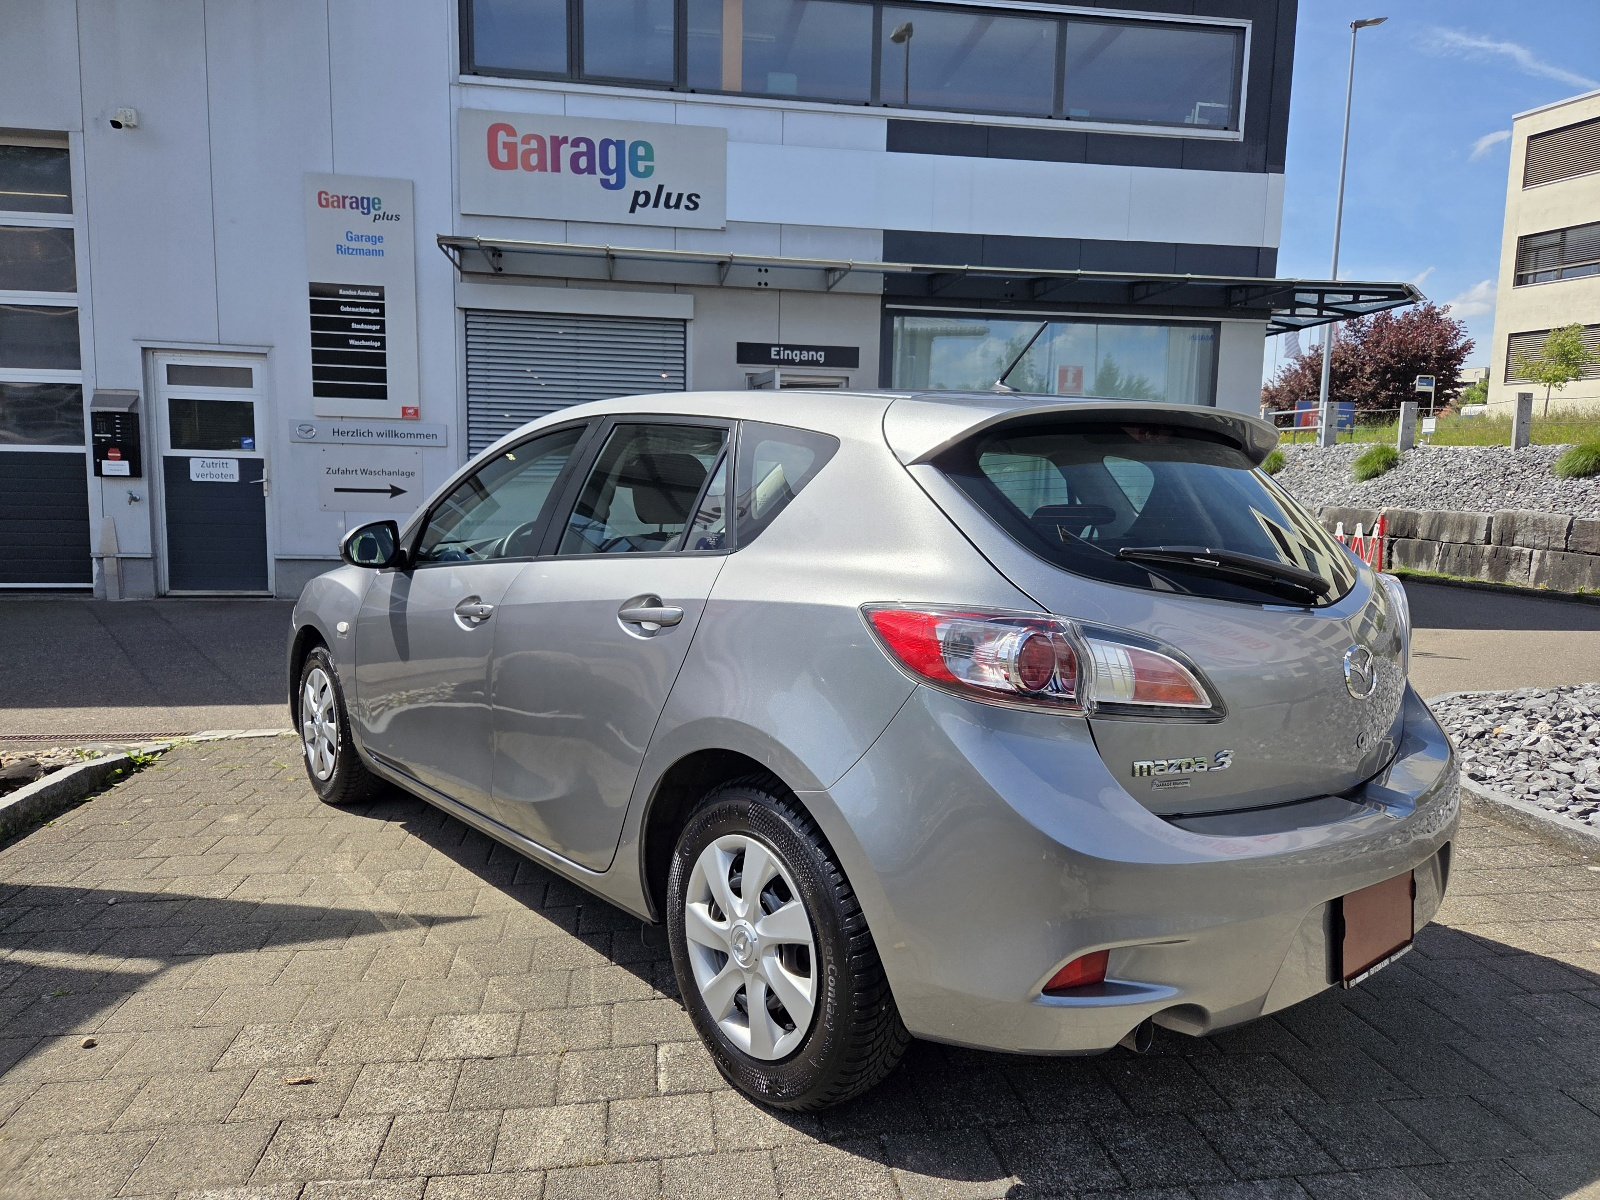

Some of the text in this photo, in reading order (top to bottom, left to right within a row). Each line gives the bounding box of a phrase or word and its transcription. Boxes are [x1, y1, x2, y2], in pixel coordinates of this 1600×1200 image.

[487, 122, 655, 190] Garage
[317, 190, 382, 215] Garage
[628, 184, 701, 213] plus
[373, 211, 400, 223] plus
[345, 230, 384, 245] Garage
[336, 244, 385, 257] Ritzmann
[770, 347, 825, 363] Eingang
[332, 428, 438, 440] Herzlich willkommen
[200, 460, 229, 469] Zutritt
[195, 471, 235, 480] verboten
[326, 467, 416, 478] Zufahrt Waschanlage
